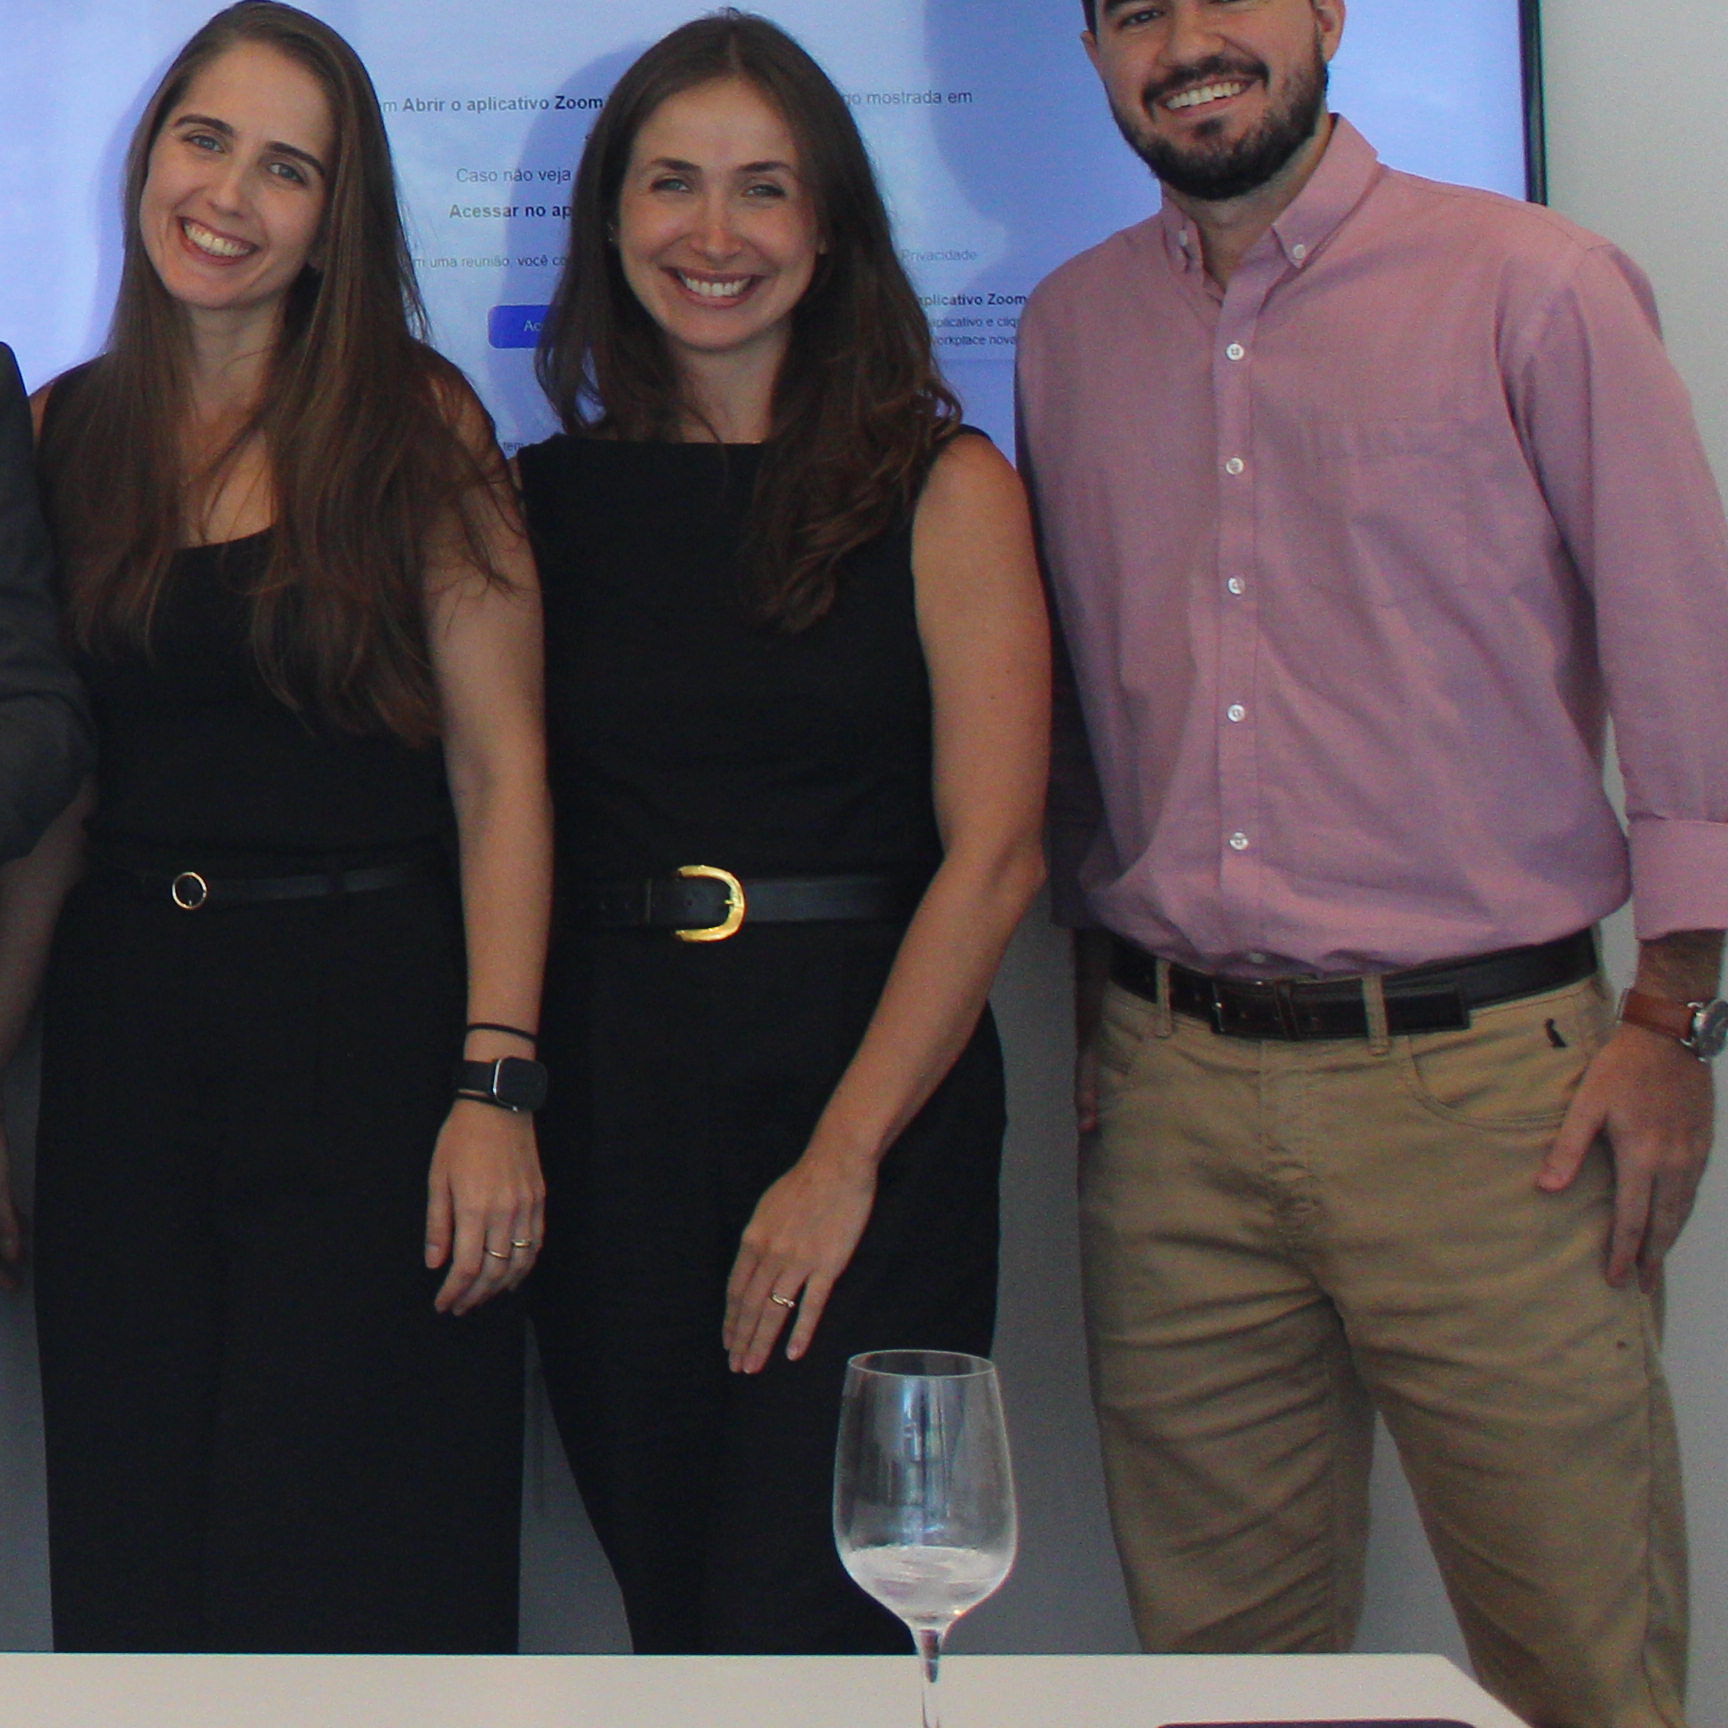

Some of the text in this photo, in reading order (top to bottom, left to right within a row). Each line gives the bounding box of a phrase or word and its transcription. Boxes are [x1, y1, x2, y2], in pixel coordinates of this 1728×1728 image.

[867, 89, 941, 104] mostrada
[947, 90, 973, 104] em
[402, 95, 604, 114] Abrir o aplicativo Zoom
[456, 167, 571, 185] Caso não veja
[449, 203, 519, 218] Acessar
[525, 205, 547, 217] no
[430, 257, 457, 268] uma
[517, 254, 548, 267] você
[987, 292, 1028, 306] Zoom
